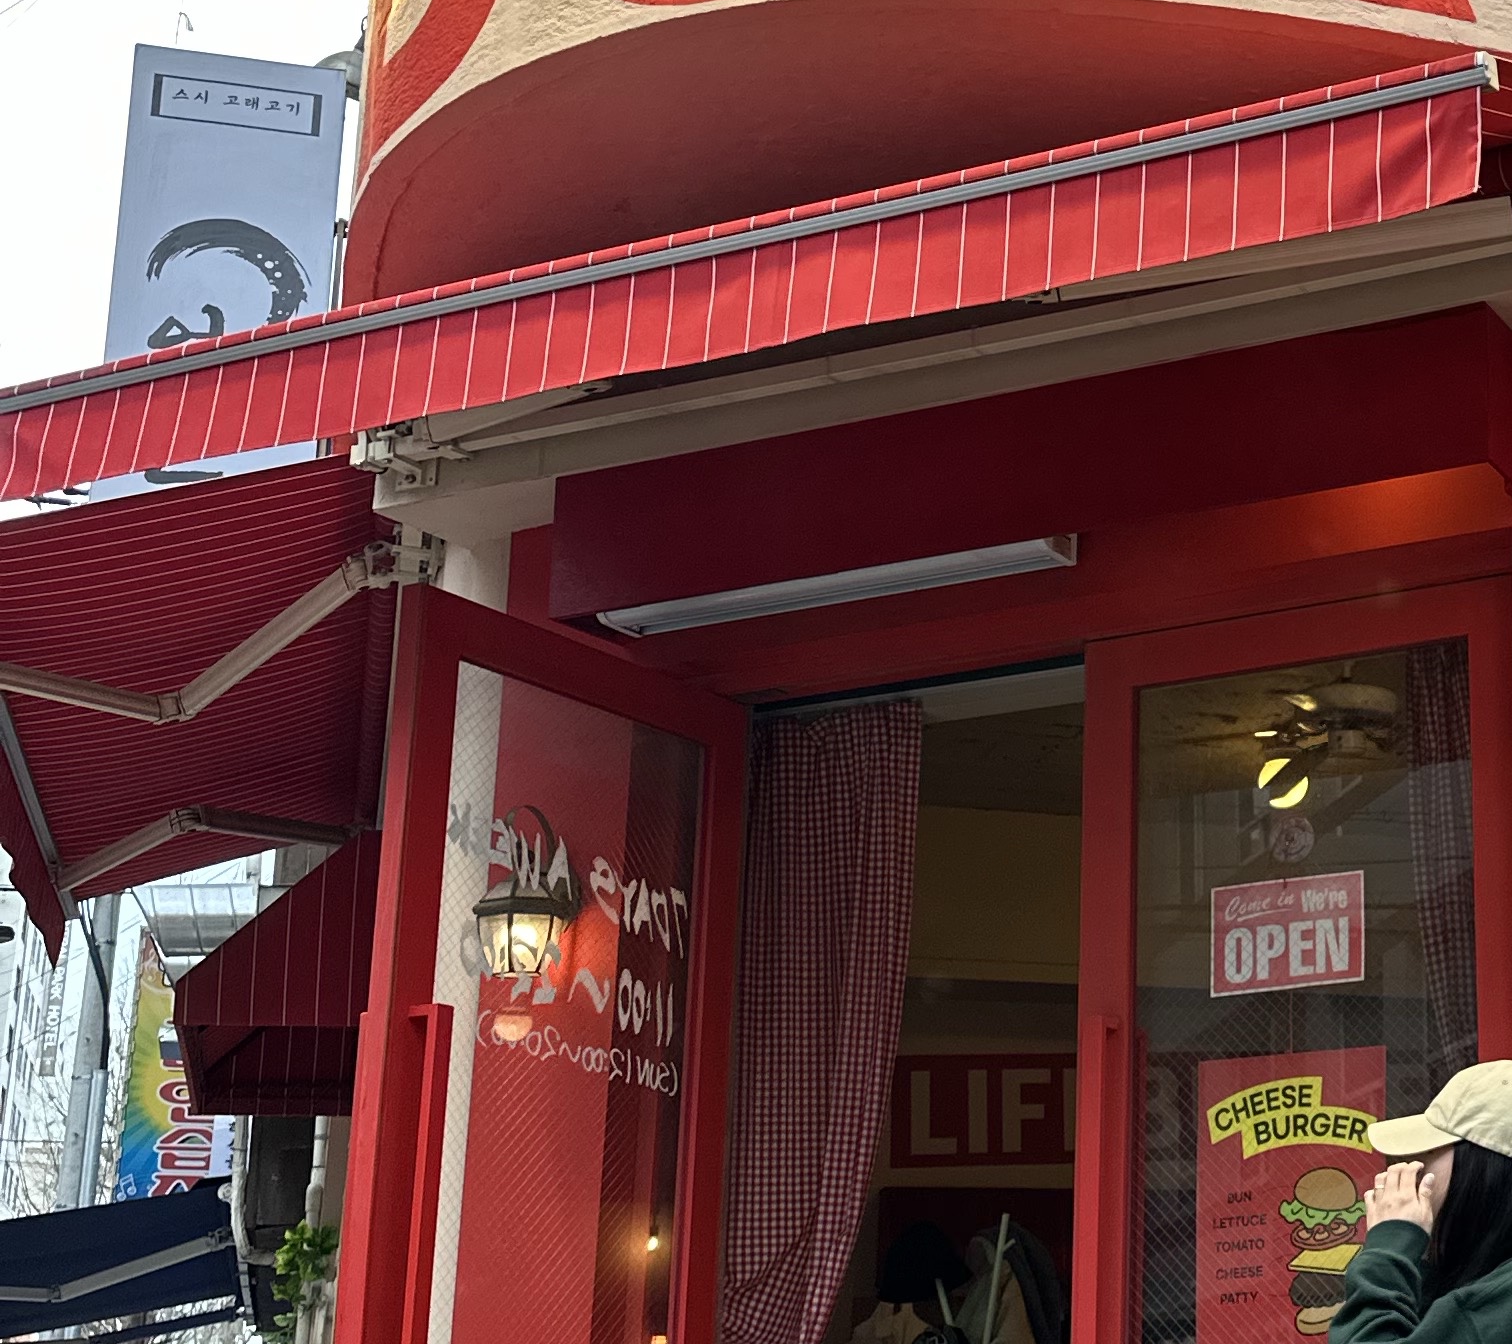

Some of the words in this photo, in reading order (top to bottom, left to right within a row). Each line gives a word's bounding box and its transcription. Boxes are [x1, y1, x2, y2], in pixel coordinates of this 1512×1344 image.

[171, 88, 209, 105] 스시
[222, 95, 301, 116] 고래고기
[1224, 895, 1272, 922] Come
[1277, 890, 1295, 906] in
[1301, 887, 1348, 913] We're
[1224, 916, 1349, 984] OPEN
[910, 1067, 1077, 1156] LIF
[1213, 1084, 1314, 1132] CHEESE
[1253, 1112, 1369, 1146] BURGER
[1227, 1190, 1252, 1204] BUN
[1212, 1214, 1268, 1230] LETTUCE
[1215, 1238, 1265, 1253] TOMATO
[1215, 1266, 1264, 1281] CHEESE
[1219, 1291, 1259, 1305] PATTY
